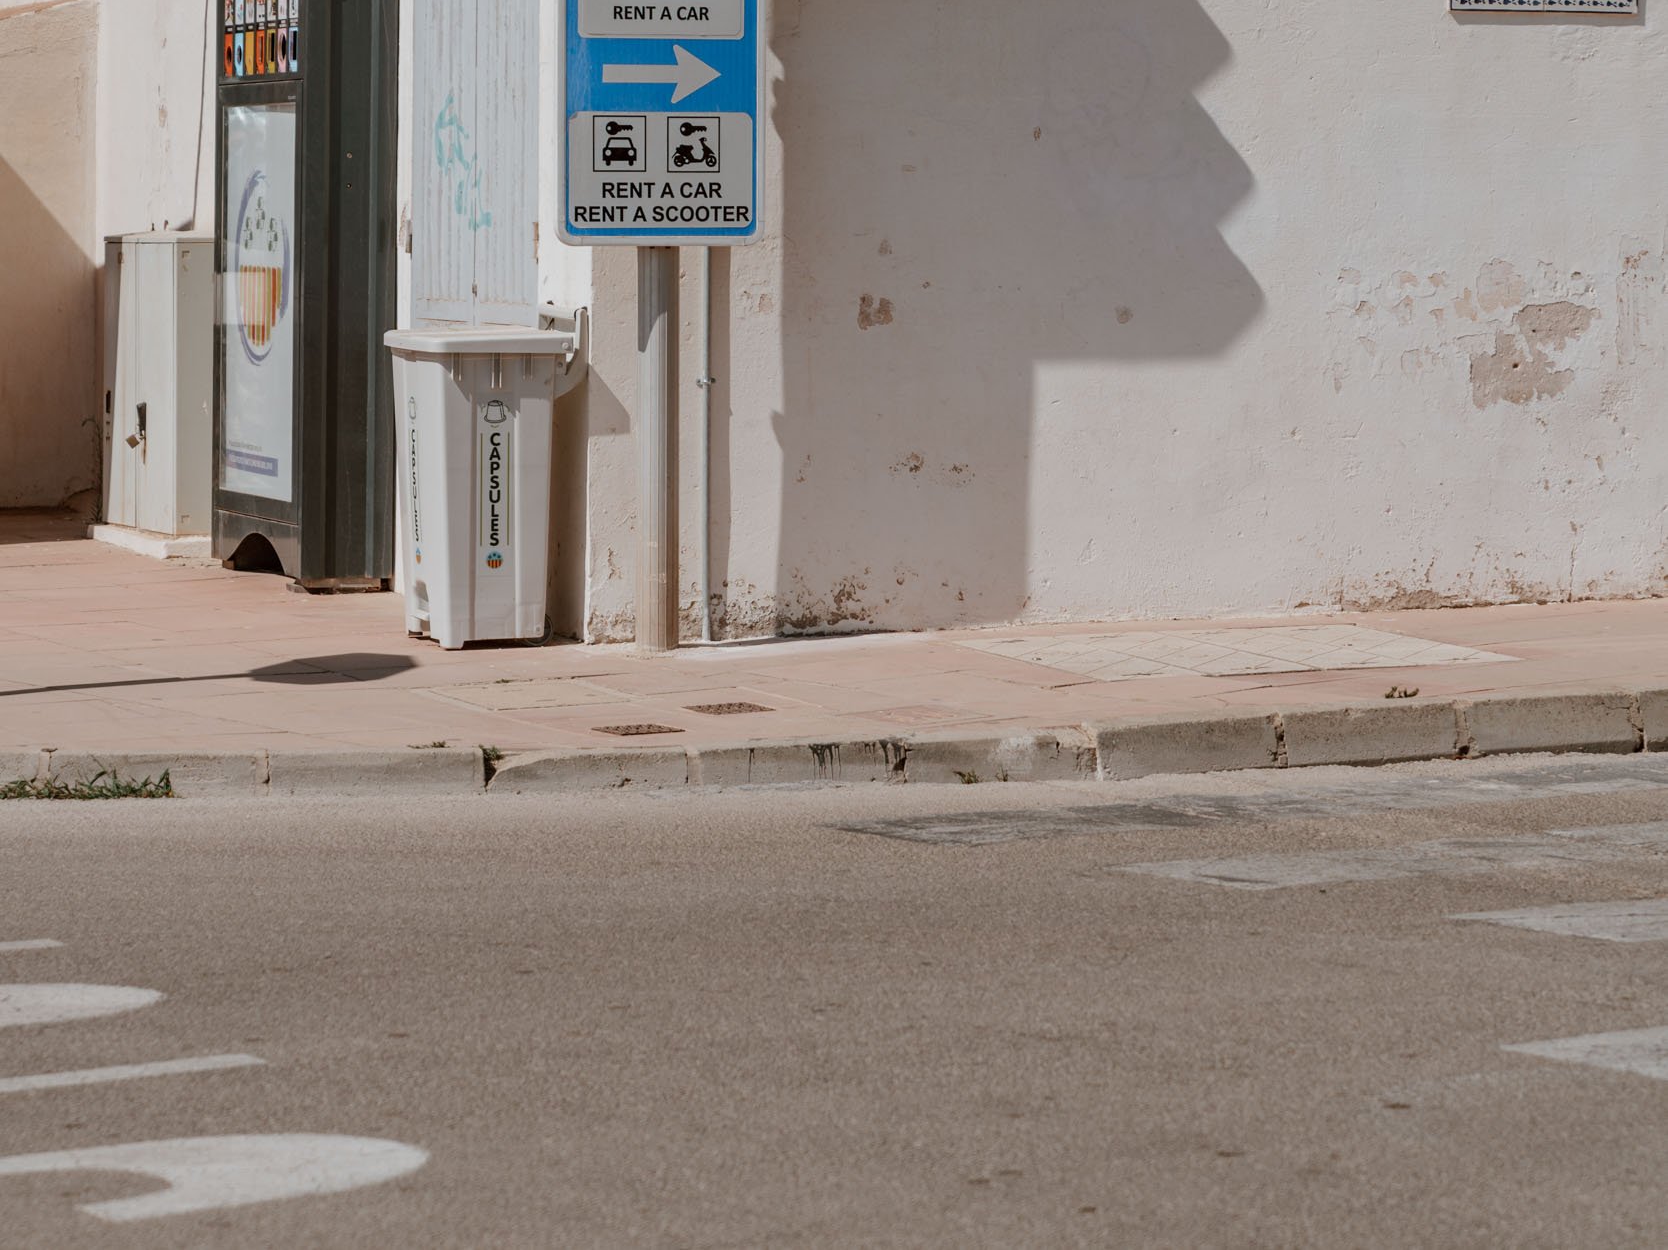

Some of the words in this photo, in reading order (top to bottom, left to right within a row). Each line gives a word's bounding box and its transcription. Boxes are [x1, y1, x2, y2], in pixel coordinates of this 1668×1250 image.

[613, 5, 656, 20] RENT
[660, 6, 672, 20] A
[676, 6, 710, 21] CAR
[602, 182, 656, 199] RENT
[660, 182, 675, 199] A
[682, 182, 722, 199] CAR
[574, 205, 628, 223] RENT
[632, 205, 647, 222] A
[652, 205, 750, 223] SCOOTER
[488, 432, 501, 547] CAPSULES
